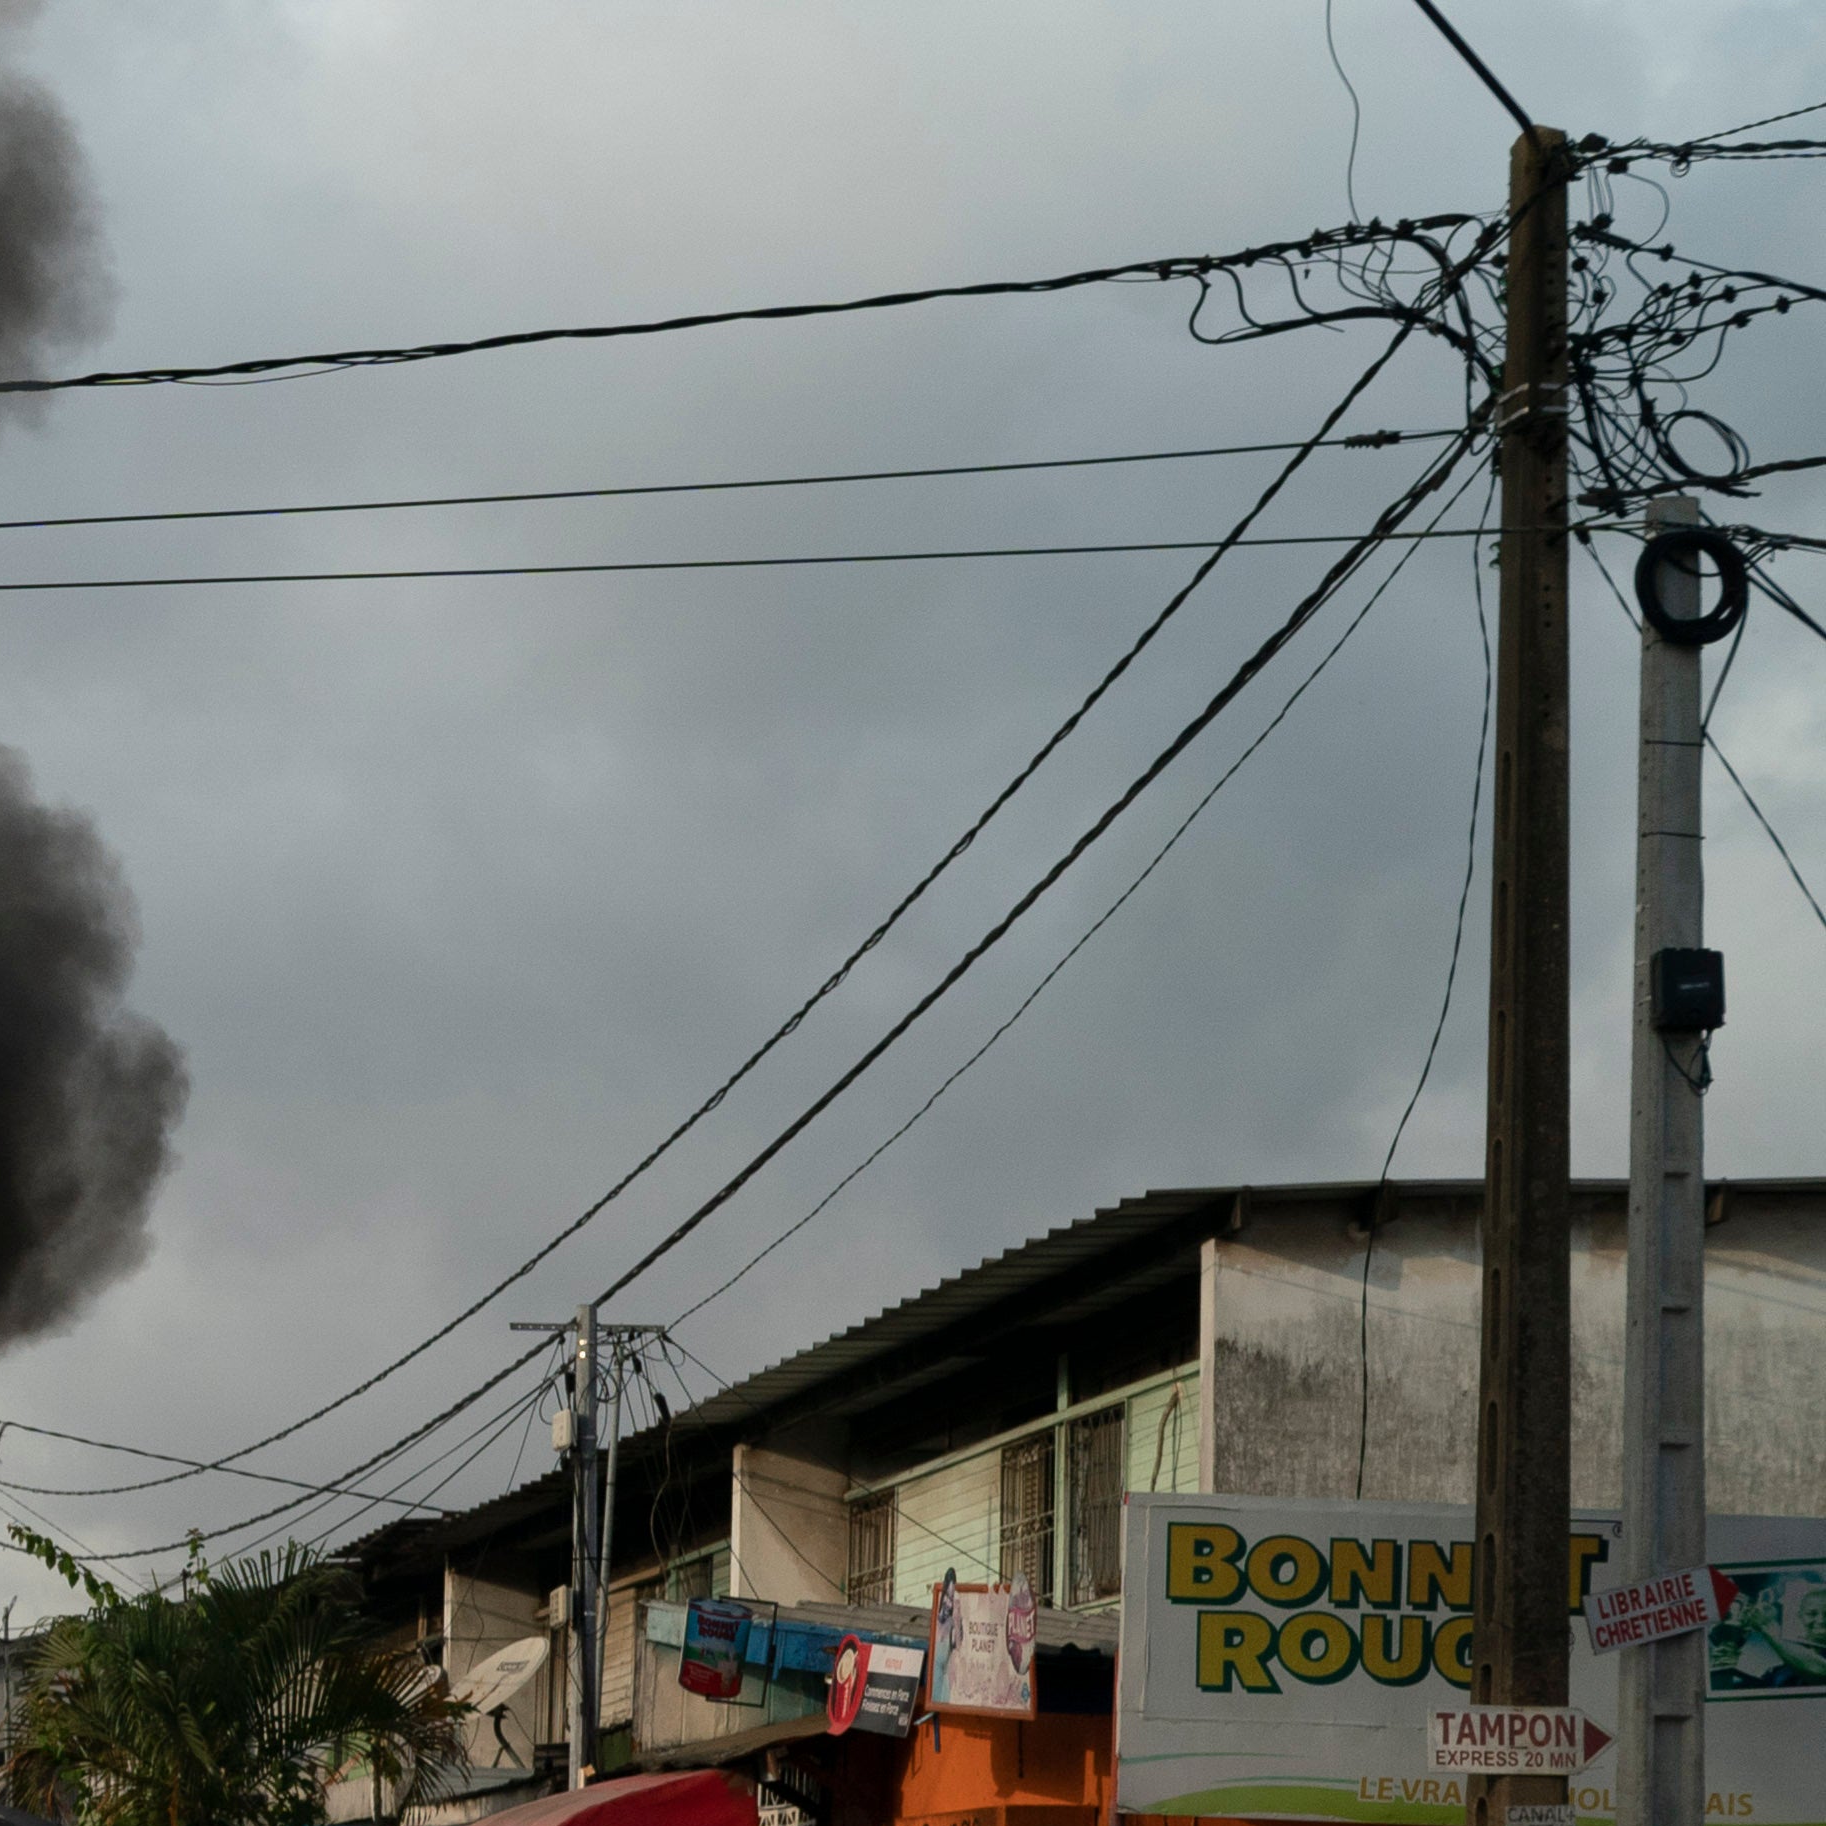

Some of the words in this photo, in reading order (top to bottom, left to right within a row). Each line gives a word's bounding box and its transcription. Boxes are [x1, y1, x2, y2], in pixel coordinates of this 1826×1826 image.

[1167, 1522, 1609, 1616] BONNT
[1597, 1574, 1695, 1620] LIBRAIRIE
[969, 1621, 1000, 1637] BOUTIQUE
[1008, 1608, 1035, 1640] PLANET
[1596, 1599, 1709, 1648] CHRETIENNE
[972, 1638, 995, 1652] PLANET
[1197, 1612, 1474, 1693] ROUG
[1436, 1713, 1577, 1747] TAMPON
[1436, 1750, 1520, 1767] EXPRESS
[1524, 1752, 1545, 1767] 20
[1550, 1754, 1577, 1769] MN
[1359, 1775, 1393, 1800] LE
[1399, 1778, 1464, 1804] VRA
[1508, 1807, 1576, 1823] CANAL+
